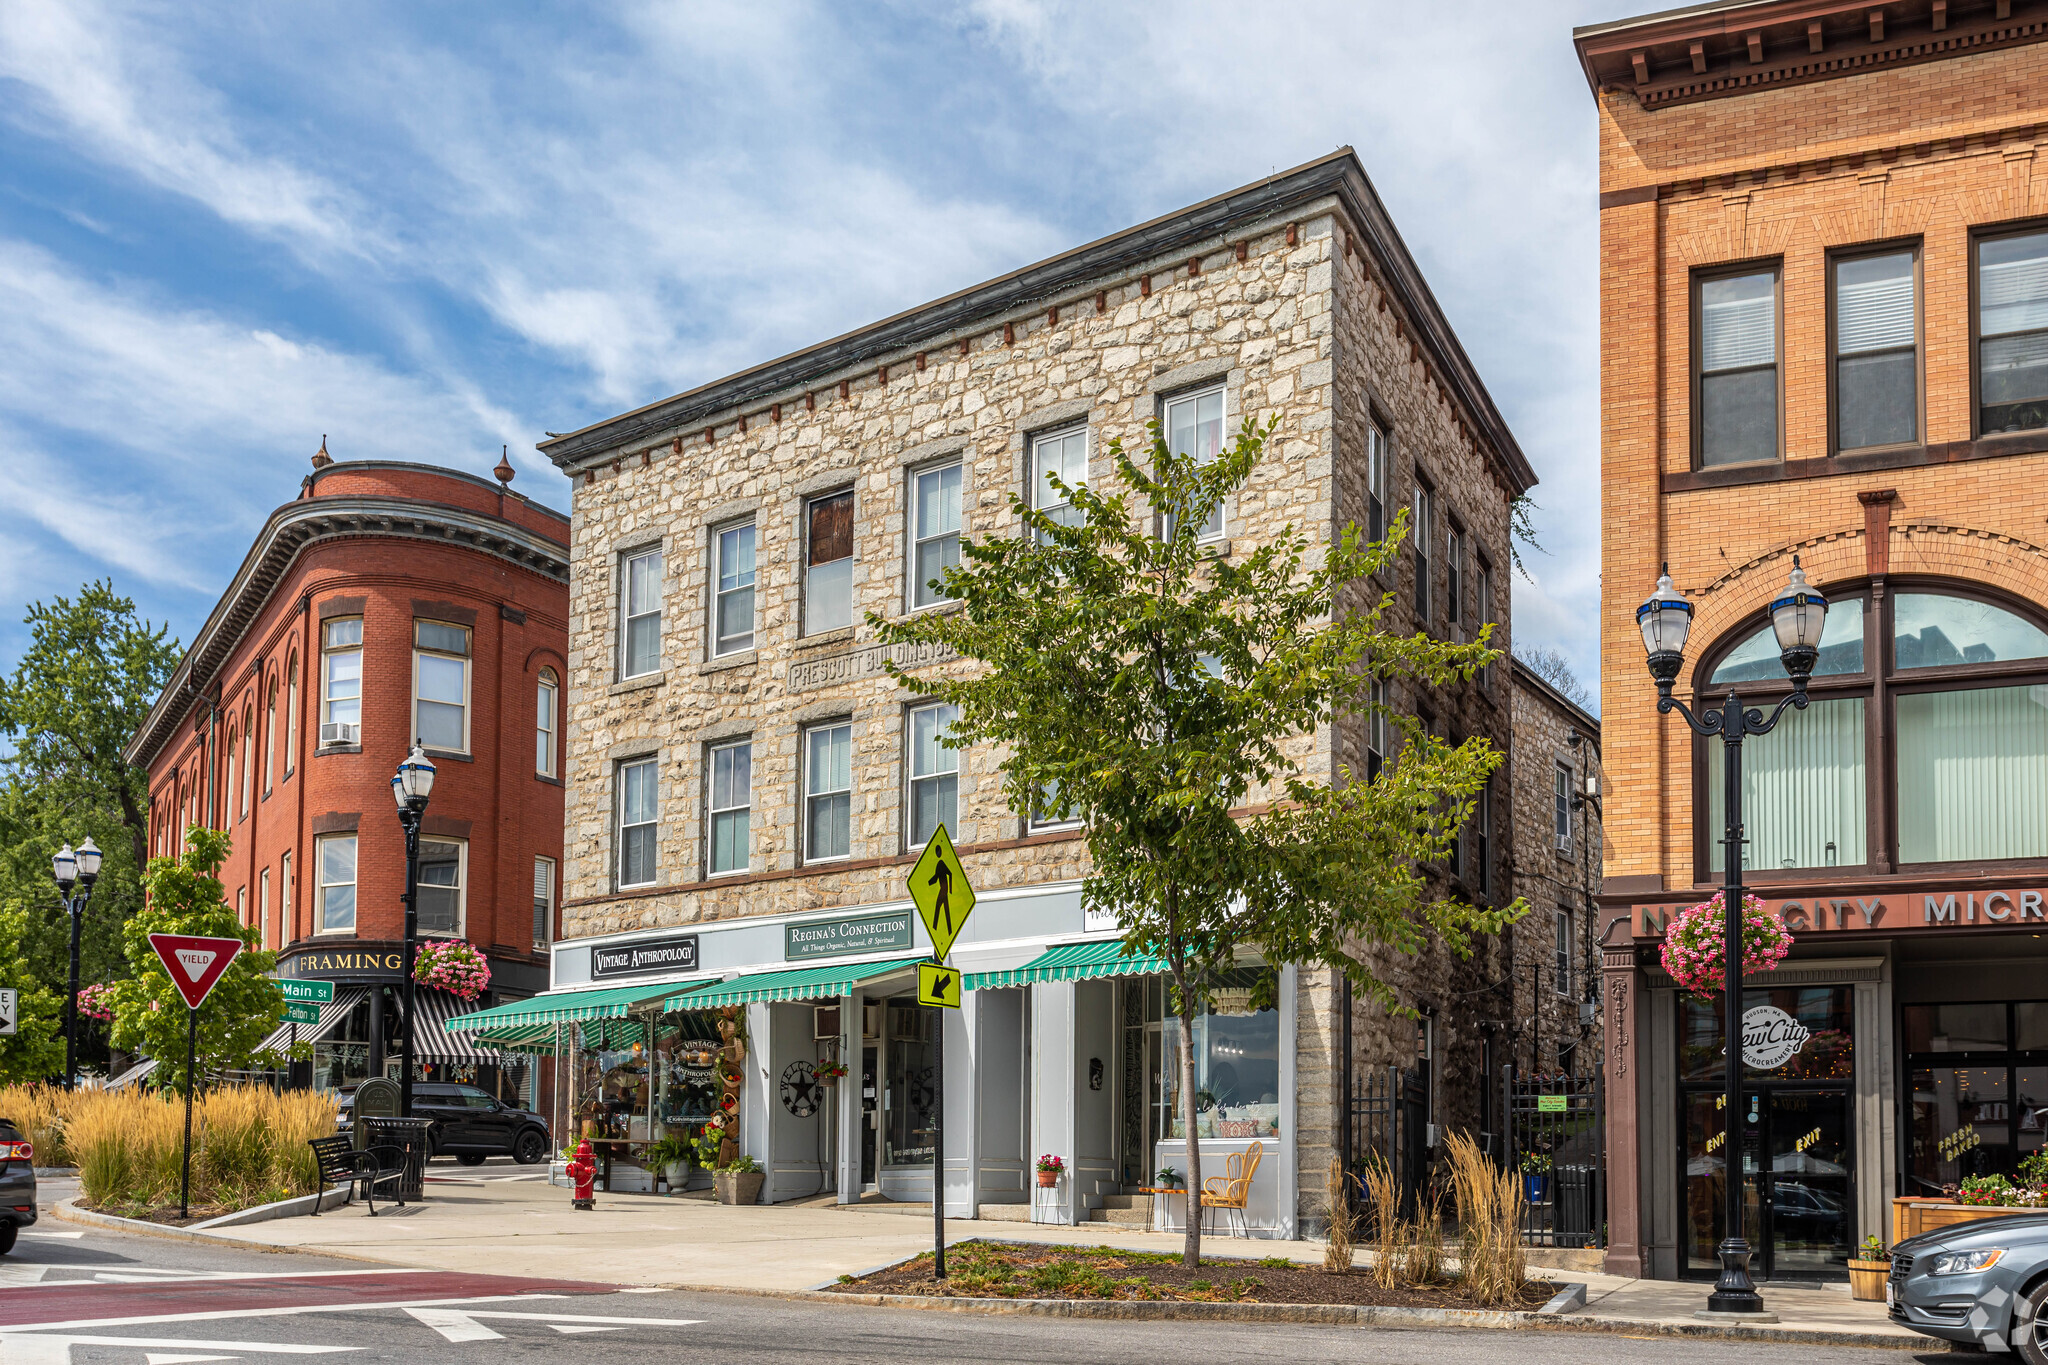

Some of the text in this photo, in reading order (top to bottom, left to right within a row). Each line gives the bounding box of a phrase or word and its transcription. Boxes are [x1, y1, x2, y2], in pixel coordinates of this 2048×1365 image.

[793, 653, 862, 687] PRESCOTT
[1780, 890, 2044, 928] CITY MICR
[839, 920, 906, 937] CONNECTION
[801, 935, 895, 953] All Things Organic, Natural, & Spiritual
[182, 954, 209, 964] YIELD
[300, 954, 403, 971] FRAMING
[597, 946, 693, 971] VINTAGE ANTHROPOLOGY
[282, 983, 327, 998] Main St
[289, 1005, 316, 1021] Felton St
[1746, 1008, 1770, 1020] HUDSON,
[684, 1041, 718, 1050] VINTAGE
[1742, 1043, 1793, 1066] MICROCREAMERY
[1706, 1131, 1726, 1153] ENT
[1796, 1127, 1821, 1153] EXIT
[1938, 1123, 1973, 1153] FRESH
[1946, 1133, 1981, 1162] BAKED
